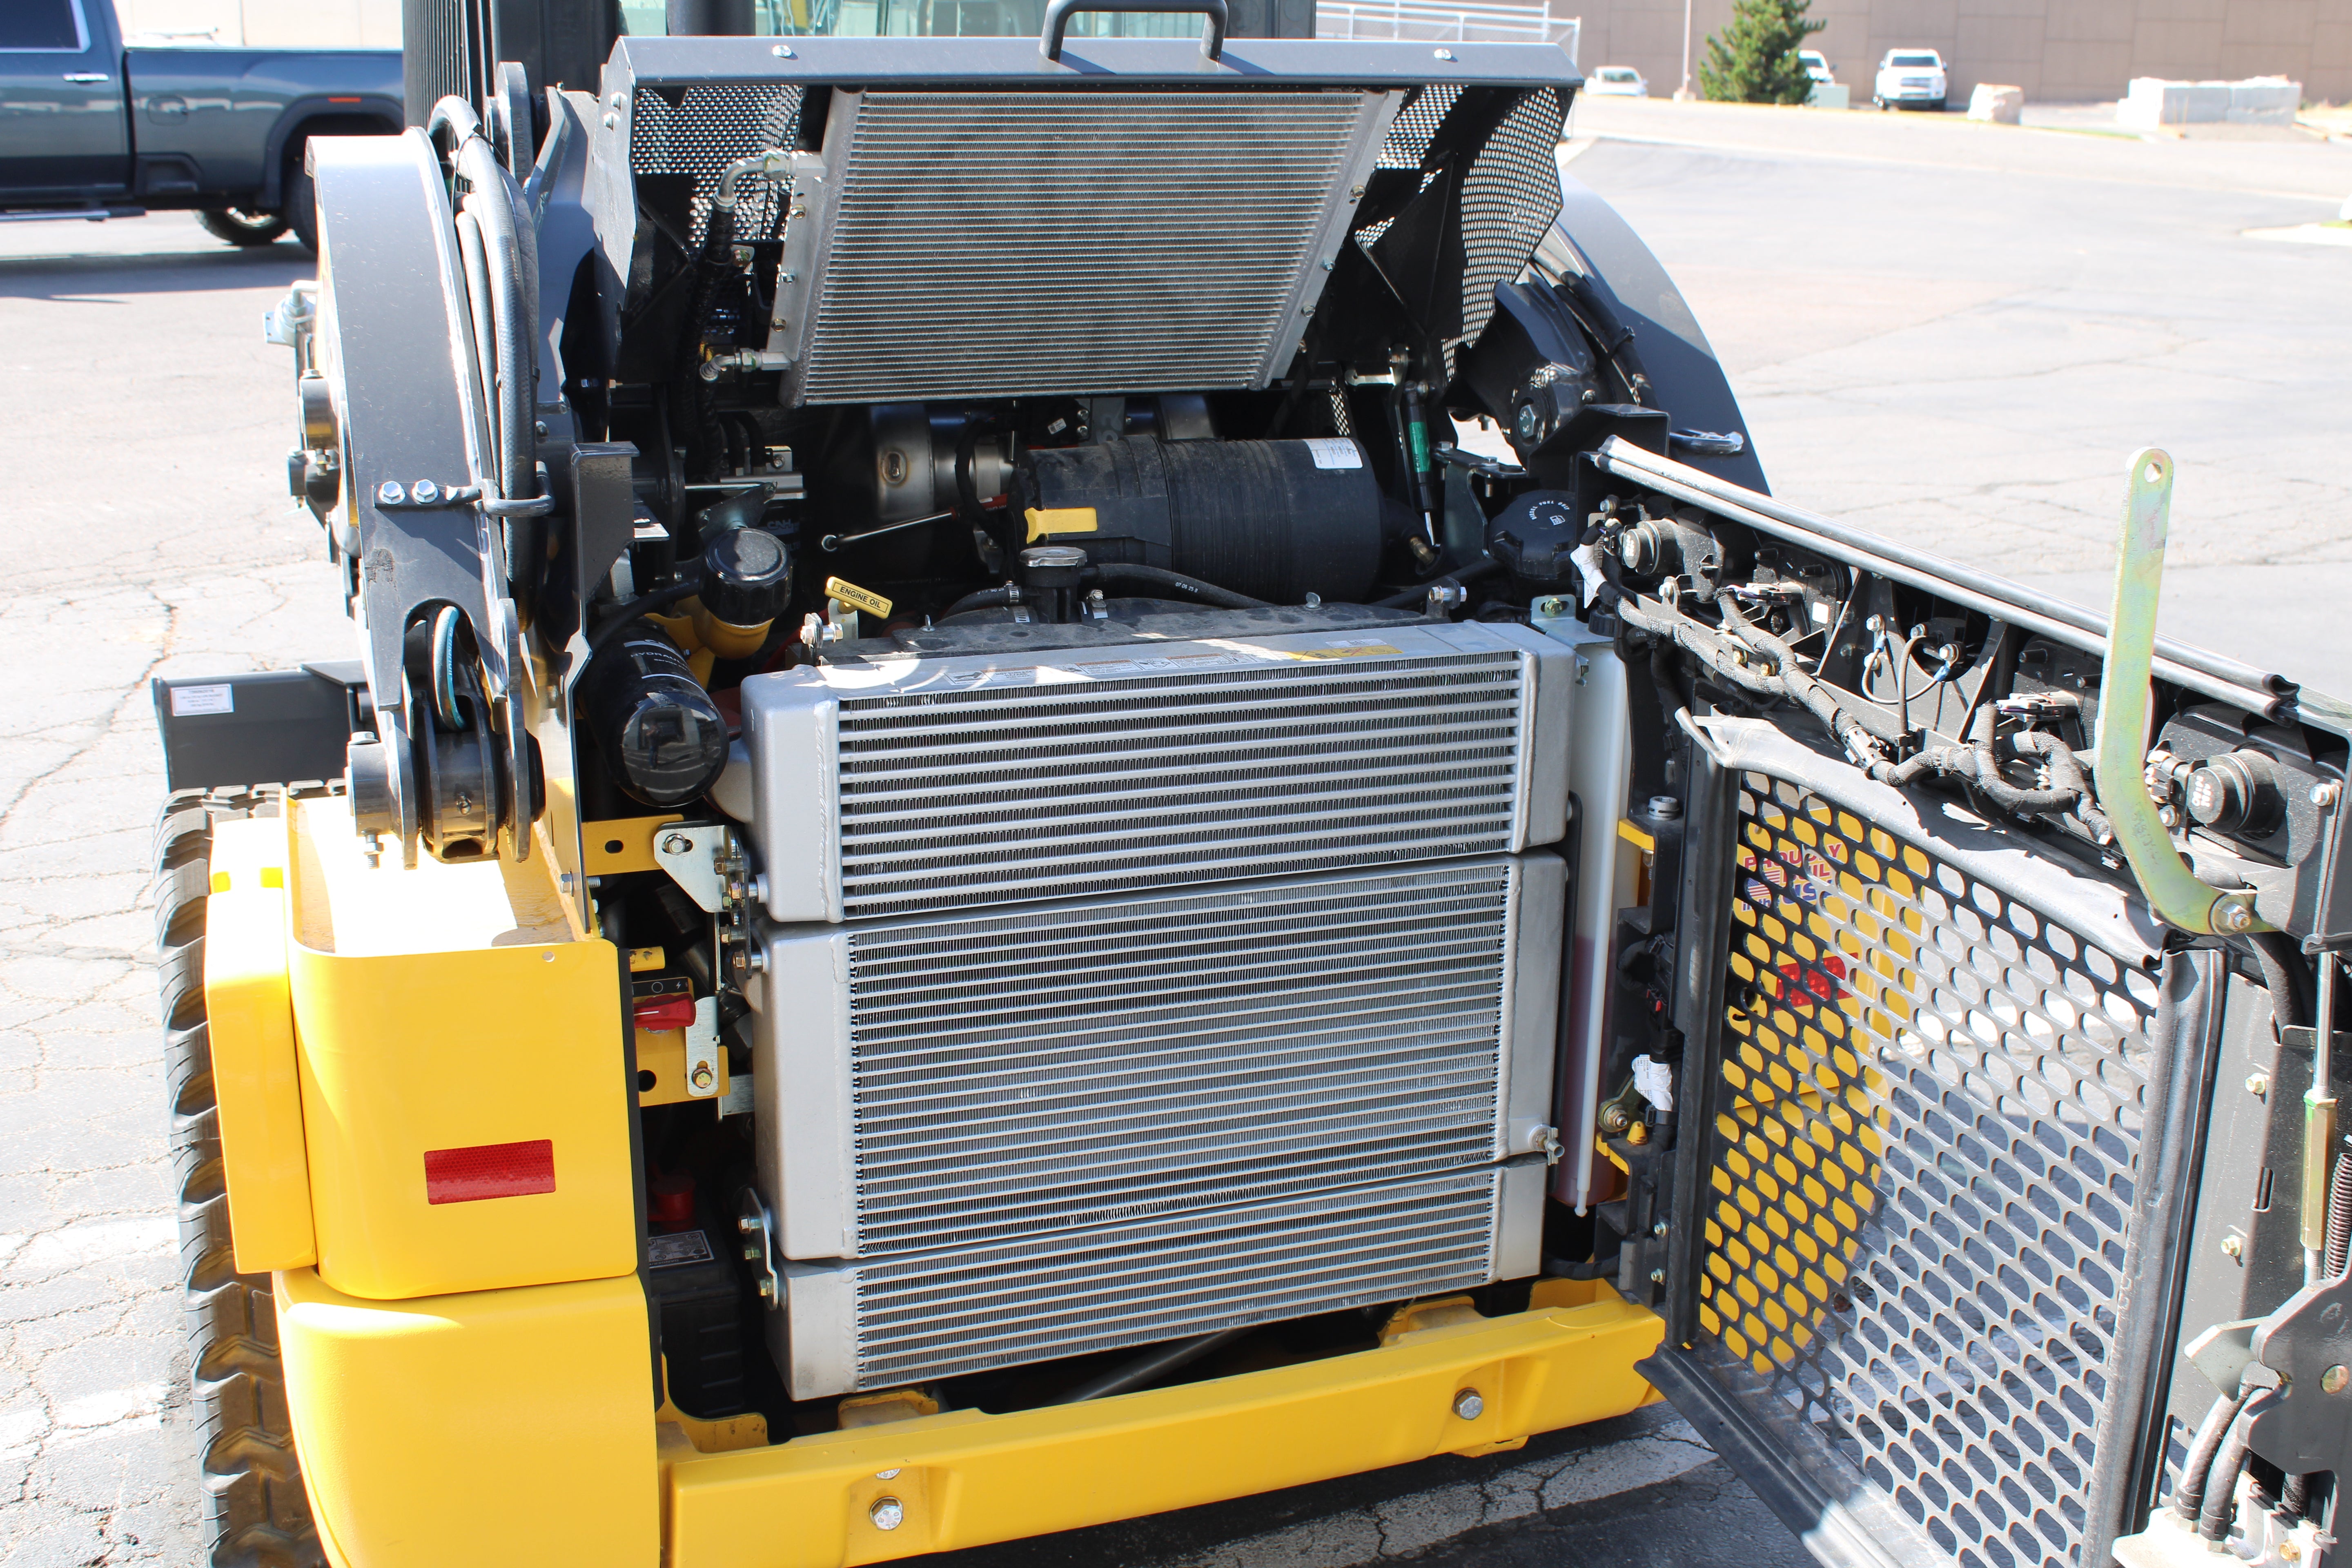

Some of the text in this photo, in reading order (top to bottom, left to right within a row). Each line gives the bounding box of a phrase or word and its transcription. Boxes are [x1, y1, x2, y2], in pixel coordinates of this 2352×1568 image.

[1529, 506, 1537, 520] DIESEL
[1557, 502, 1570, 510] ONLY
[840, 586, 880, 608] ENGINE OIL
